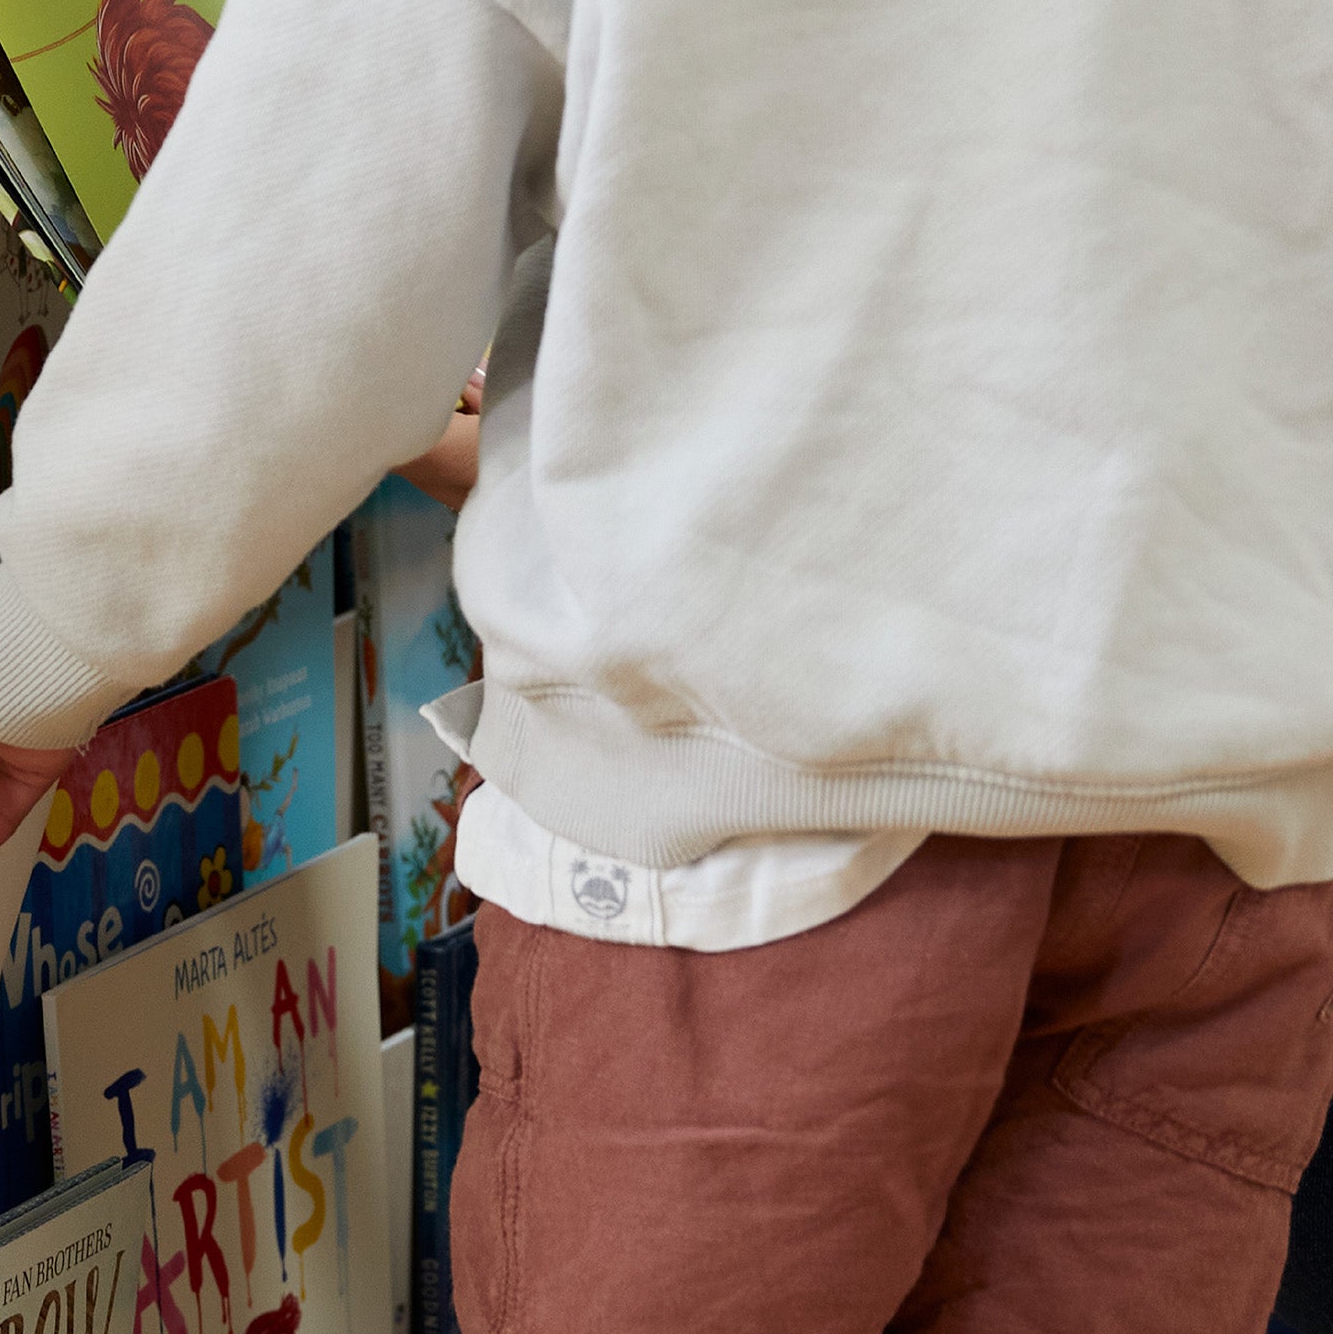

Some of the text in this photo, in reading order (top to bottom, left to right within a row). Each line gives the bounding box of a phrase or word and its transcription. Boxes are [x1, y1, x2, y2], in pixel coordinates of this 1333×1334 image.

[367, 724, 384, 754] TOO
[369, 760, 387, 807] MANY
[174, 913, 278, 1000] MARTA ALTÉS
[421, 968, 438, 1021] SCOTT
[104, 946, 338, 1167] I AM AN
[421, 1025, 438, 1074] KELLY
[50, 1111, 61, 1131] AN
[422, 1149, 439, 1213] BURTON
[2, 1266, 33, 1308] FAN
[35, 1223, 113, 1286] BROTHERS
